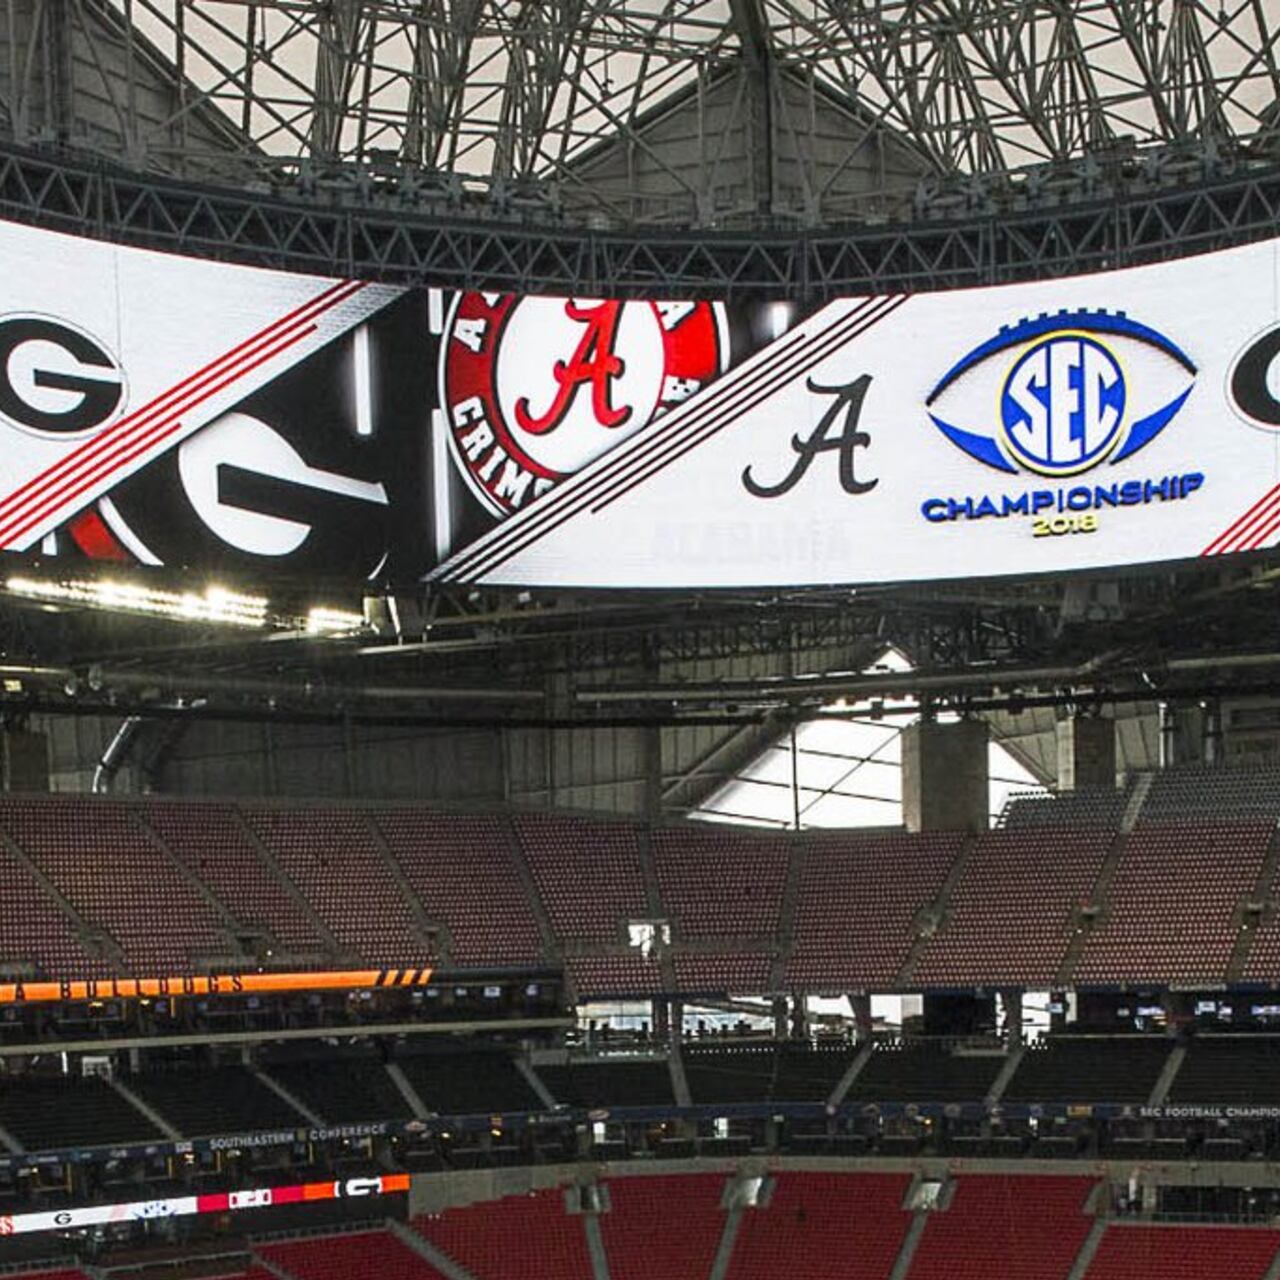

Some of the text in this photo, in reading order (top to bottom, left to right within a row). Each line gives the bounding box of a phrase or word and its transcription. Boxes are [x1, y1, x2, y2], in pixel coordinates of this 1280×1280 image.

[514, 297, 634, 436] A
[1007, 339, 1120, 464] SEC
[741, 372, 879, 498] A
[920, 471, 1206, 524] CHAMPIONSHIP
[1031, 512, 1099, 538] 2018
[60, 976, 243, 999] BULLDOGS
[1140, 1106, 1162, 1118] SEC
[1165, 1106, 1222, 1119] FOOTBALL
[209, 1132, 295, 1151] SOUTHEASTERN
[309, 1123, 387, 1141] CONFERENCE
[53, 1212, 72, 1225] G
